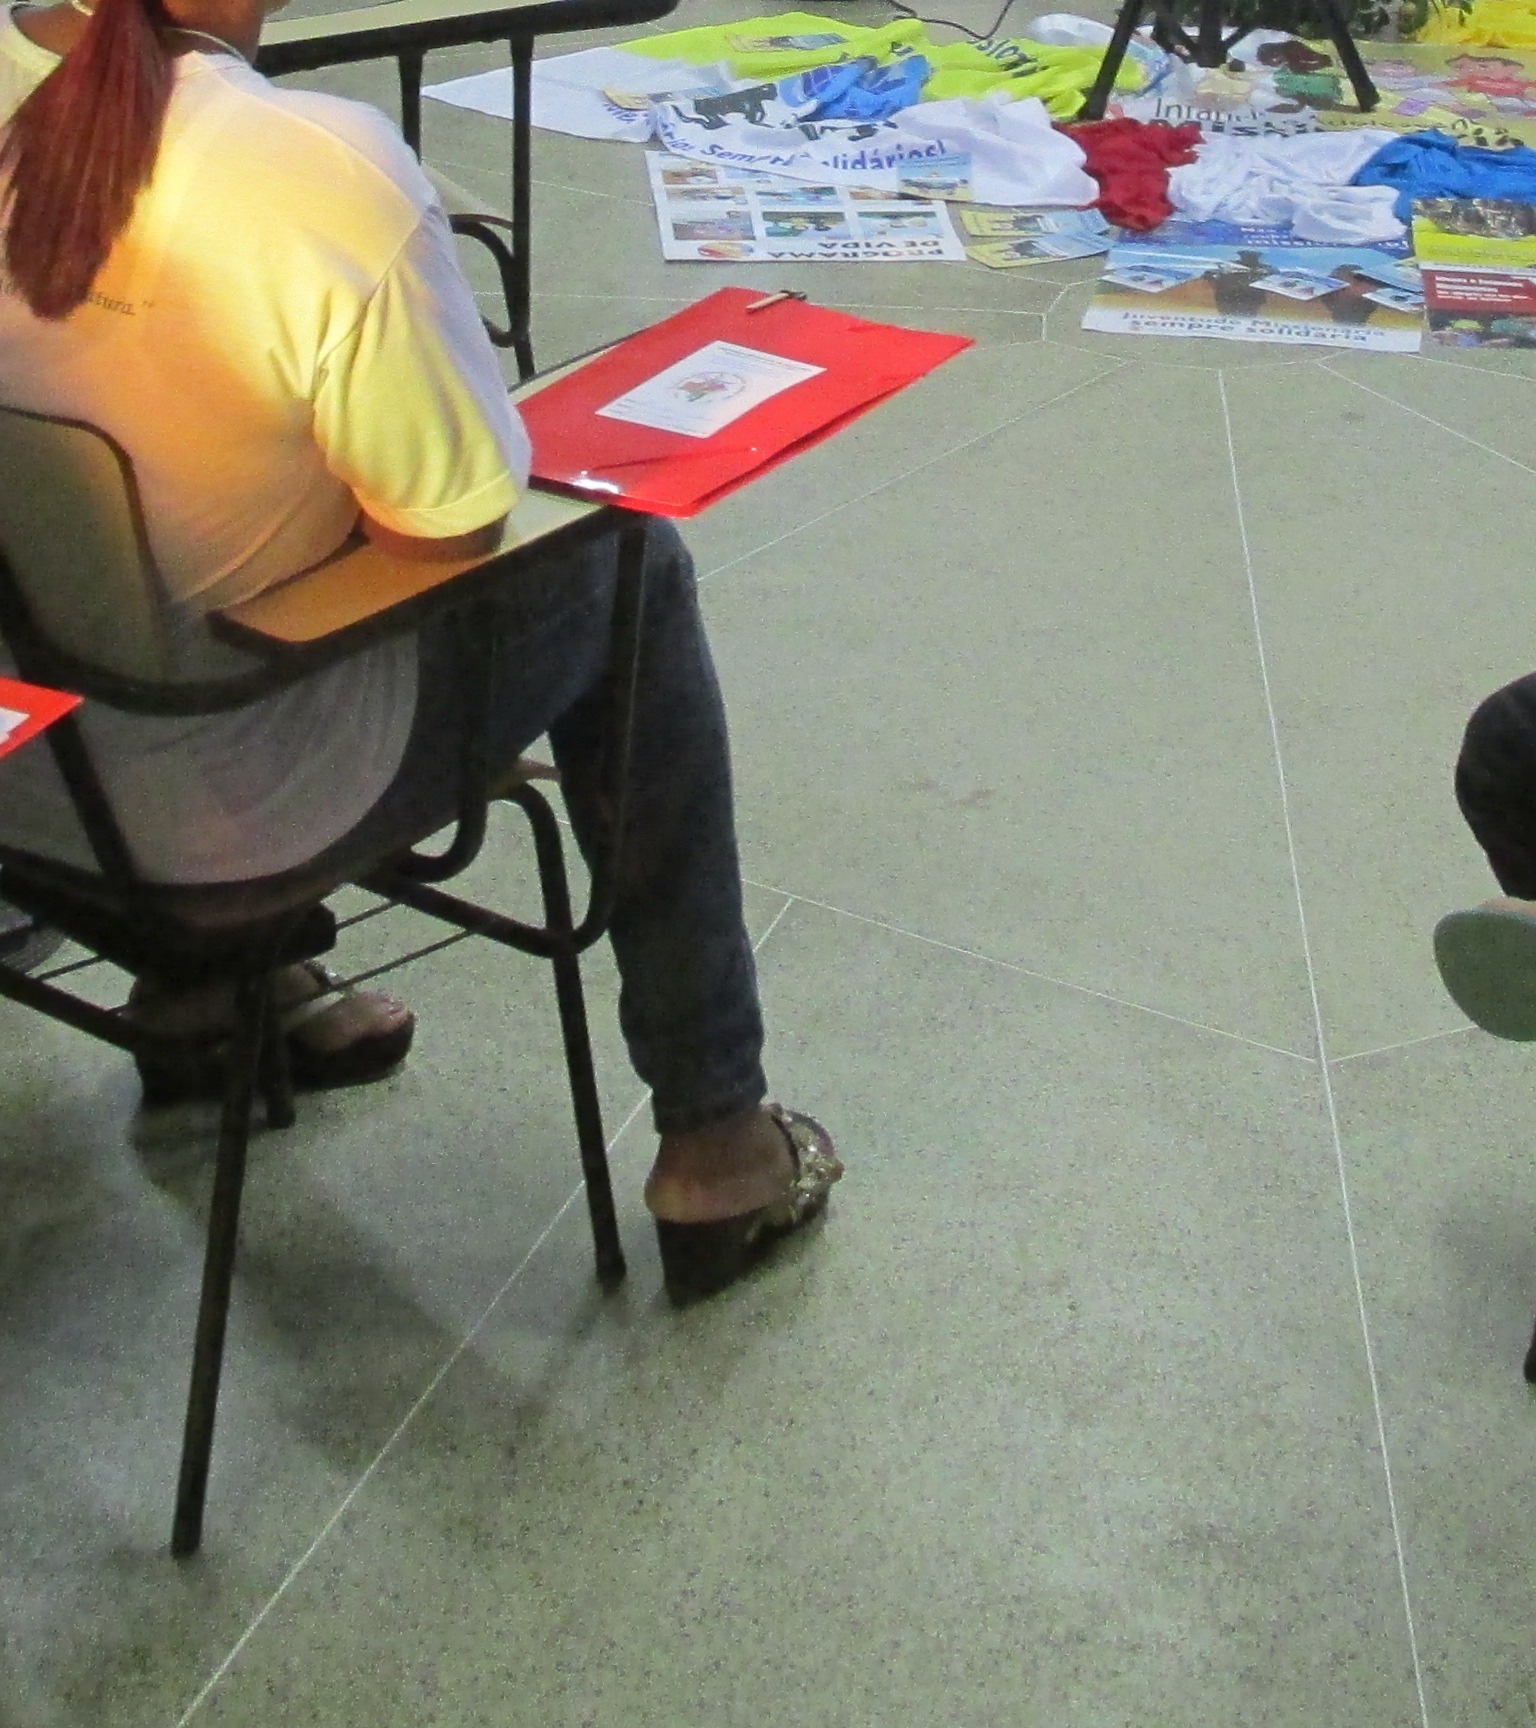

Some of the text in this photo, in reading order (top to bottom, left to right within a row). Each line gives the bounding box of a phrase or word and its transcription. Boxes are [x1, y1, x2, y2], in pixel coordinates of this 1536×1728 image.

[817, 241, 897, 249] VIDA
[766, 248, 945, 259] PROGRAMA
[1122, 311, 1242, 325] Juventude
[1131, 320, 1234, 332] sempre
